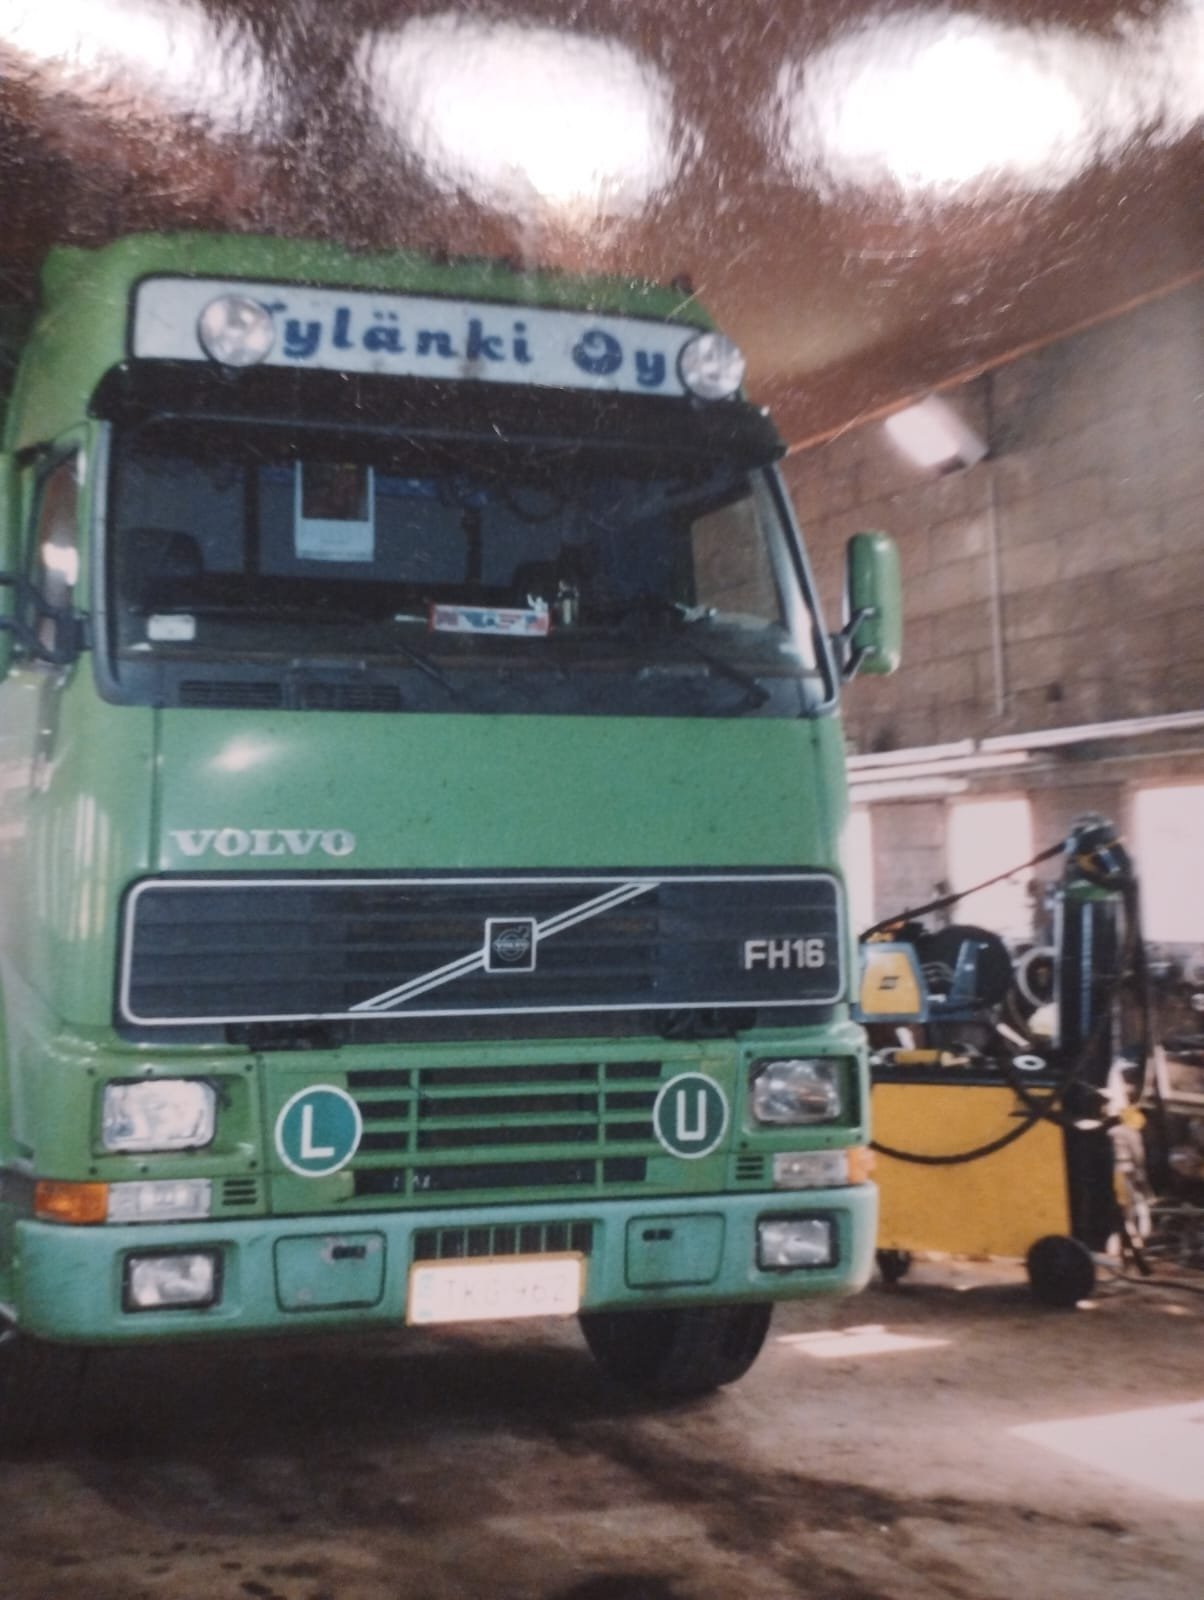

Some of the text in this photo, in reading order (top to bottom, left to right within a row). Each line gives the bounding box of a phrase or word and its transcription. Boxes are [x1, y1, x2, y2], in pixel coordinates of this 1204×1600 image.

[261, 301, 667, 388] ylänki Oy
[169, 827, 356, 857] VOLVO
[744, 938, 825, 970] FH16
[300, 1103, 336, 1160] L
[676, 1088, 707, 1142] U
